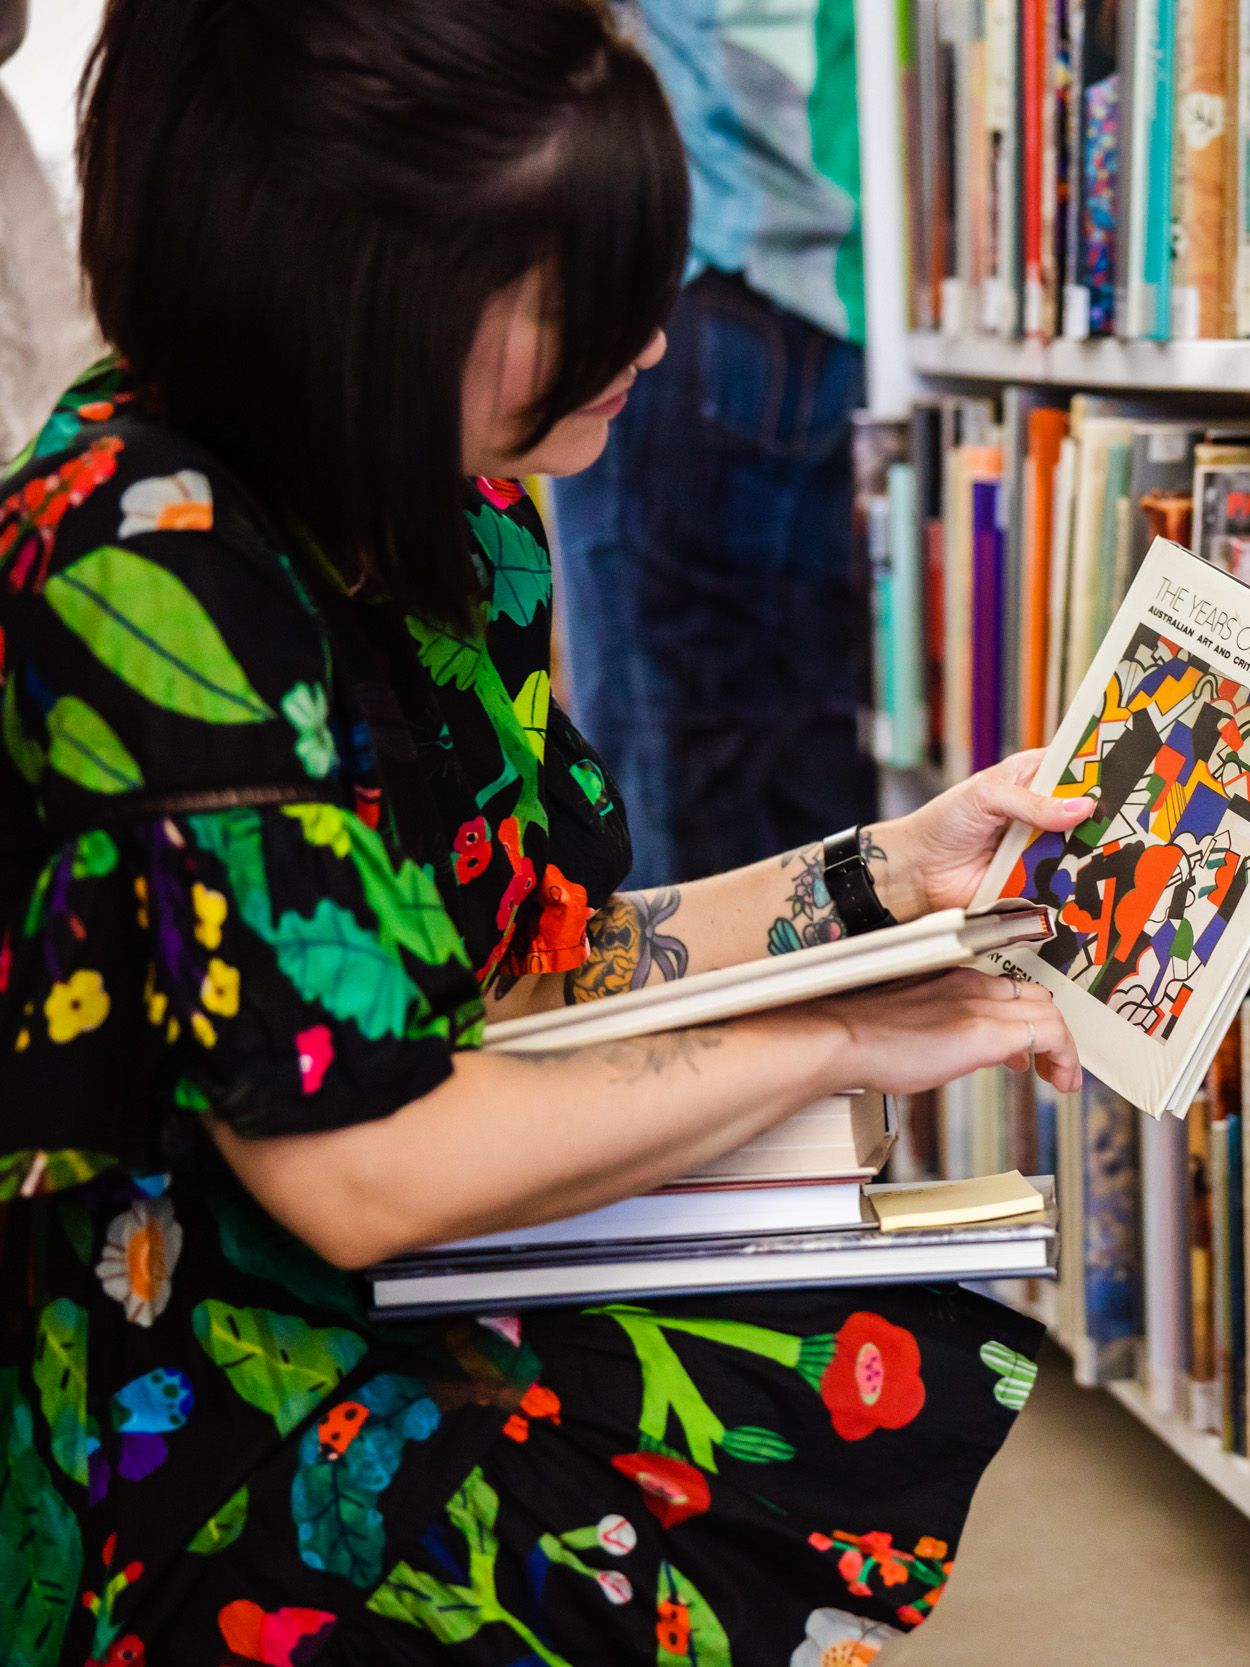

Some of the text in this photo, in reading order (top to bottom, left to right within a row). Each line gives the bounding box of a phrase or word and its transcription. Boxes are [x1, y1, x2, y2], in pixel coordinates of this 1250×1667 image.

[1148, 605, 1195, 638] AUSTRALIAN
[1196, 634, 1213, 649] ART
[1213, 645, 1231, 660] AND
[1155, 576, 1189, 612] THE
[1188, 595, 1238, 642] YEARS
